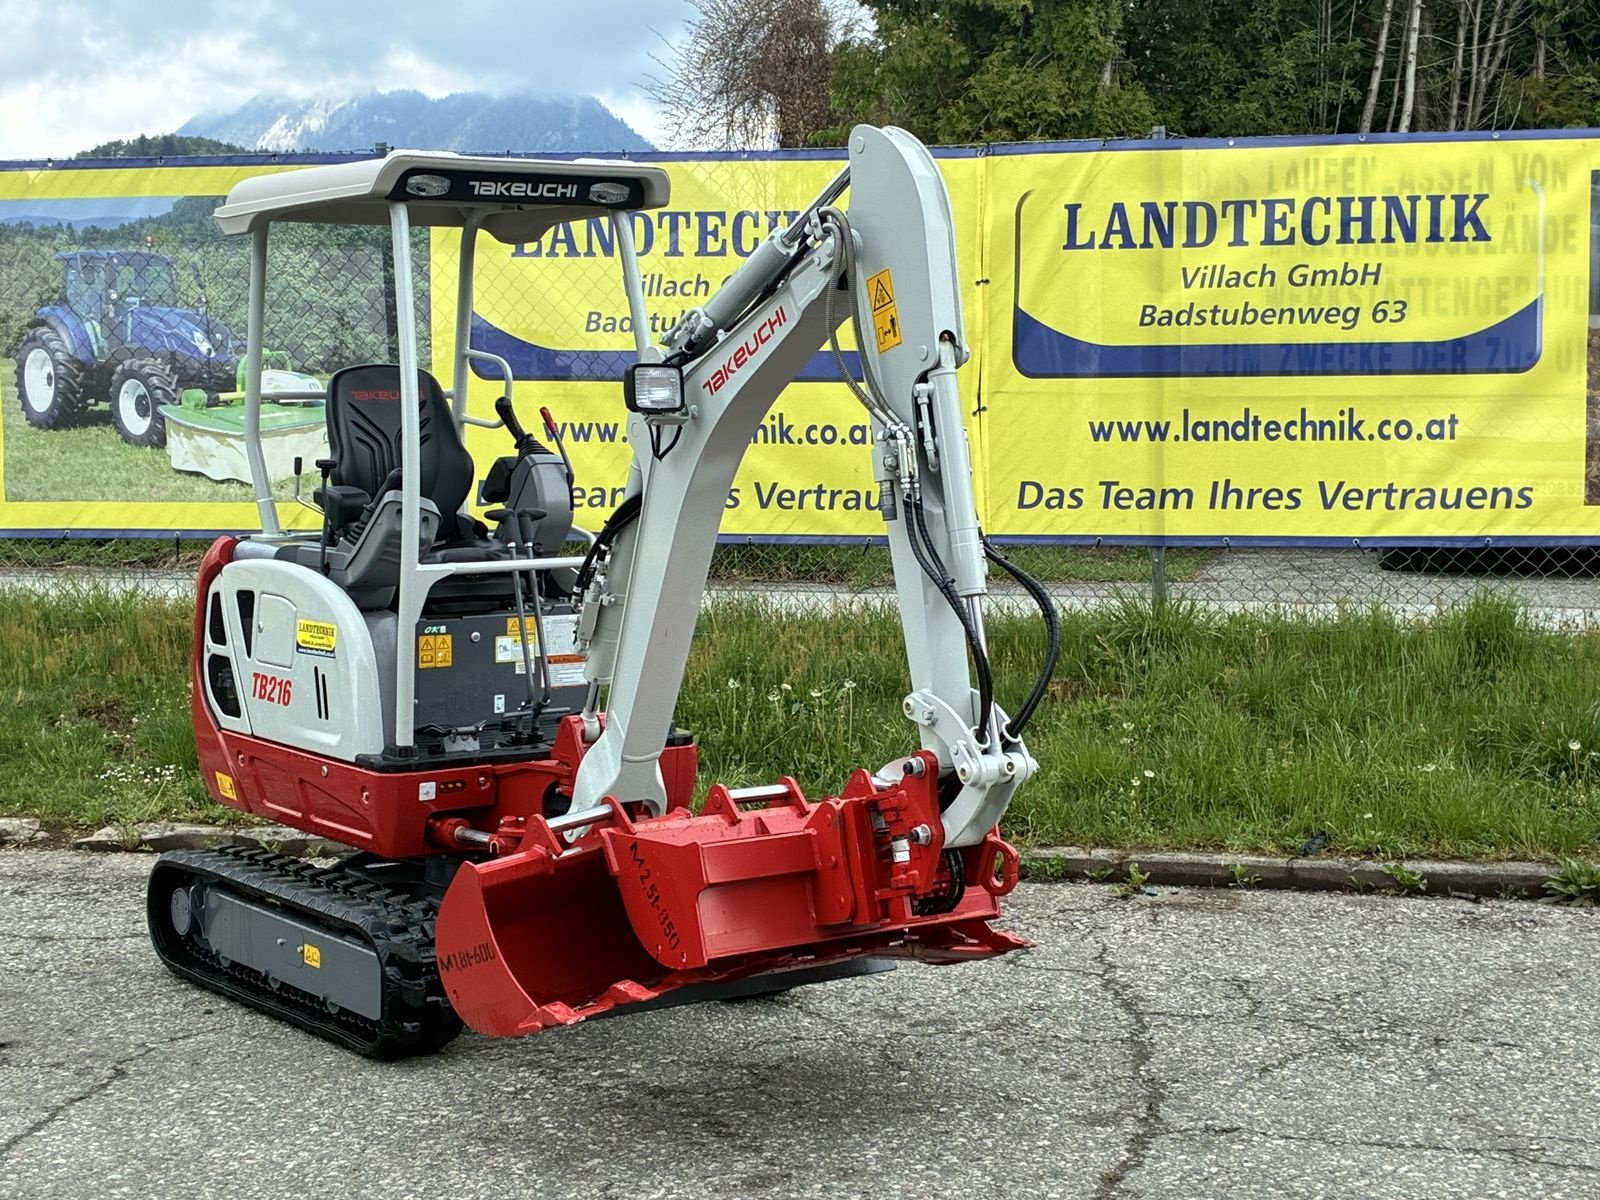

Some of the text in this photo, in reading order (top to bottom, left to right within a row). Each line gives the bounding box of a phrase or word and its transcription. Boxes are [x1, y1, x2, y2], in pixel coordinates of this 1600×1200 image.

[469, 181, 577, 198] TAKEUCHI
[1062, 193, 1492, 250] LANDTECHNIK
[640, 274, 710, 297] illach
[1181, 262, 1382, 289] Villach GmbH
[1139, 300, 1408, 330] Badstubenweg 63
[702, 305, 787, 396] TAKEUCHI
[1088, 407, 1459, 442] www.landtechnik.co.at
[754, 482, 882, 510] Vertrau
[1017, 481, 1084, 510] Das
[1098, 481, 1194, 510] Team
[1208, 479, 1302, 510] Ihres
[1318, 481, 1534, 510] Vertrauens
[252, 672, 292, 707] TB216
